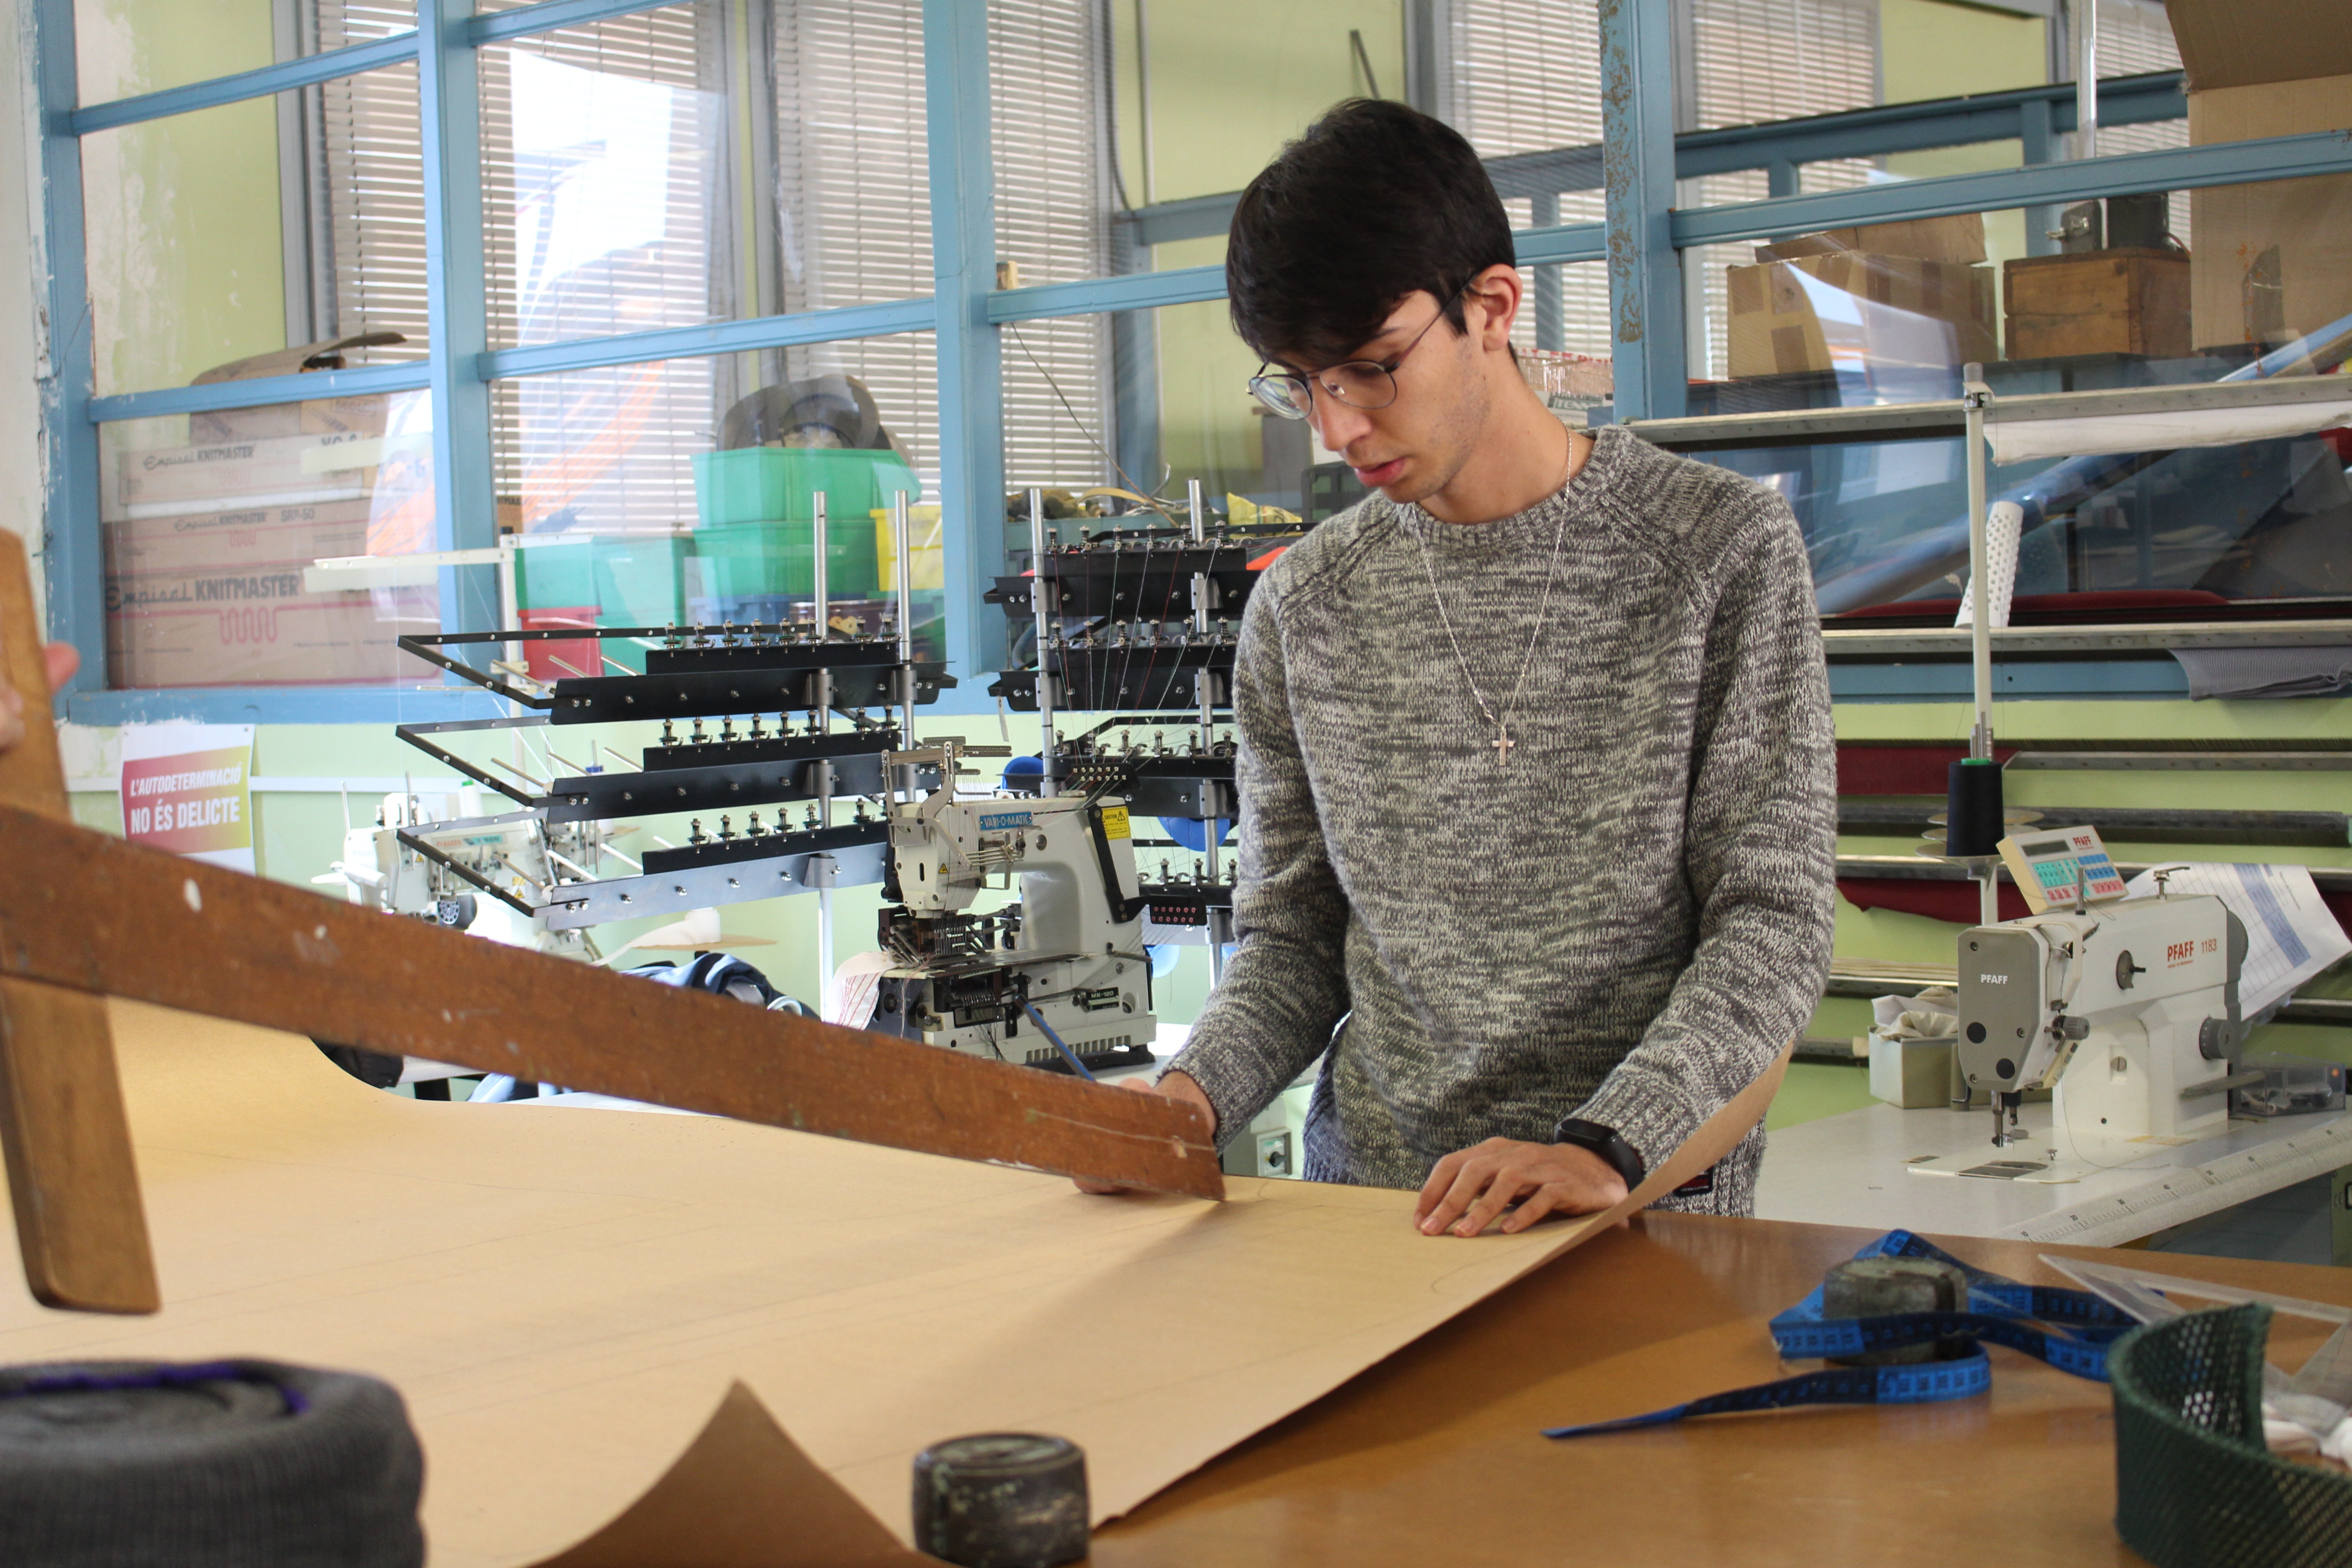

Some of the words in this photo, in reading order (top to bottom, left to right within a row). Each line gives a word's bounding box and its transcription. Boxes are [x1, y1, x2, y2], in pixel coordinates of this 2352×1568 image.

[194, 574, 300, 601] KNITMASTER
[131, 762, 242, 797] L'AUTODETERMINACIÓ
[131, 807, 151, 834] NO
[154, 799, 174, 832] ÉS
[177, 796, 240, 829] DELICTE
[2073, 836, 2092, 847] PFAFF
[2167, 941, 2194, 962] PFAFF
[2201, 938, 2217, 954] 1183
[1980, 974, 2009, 985] PFAFF
